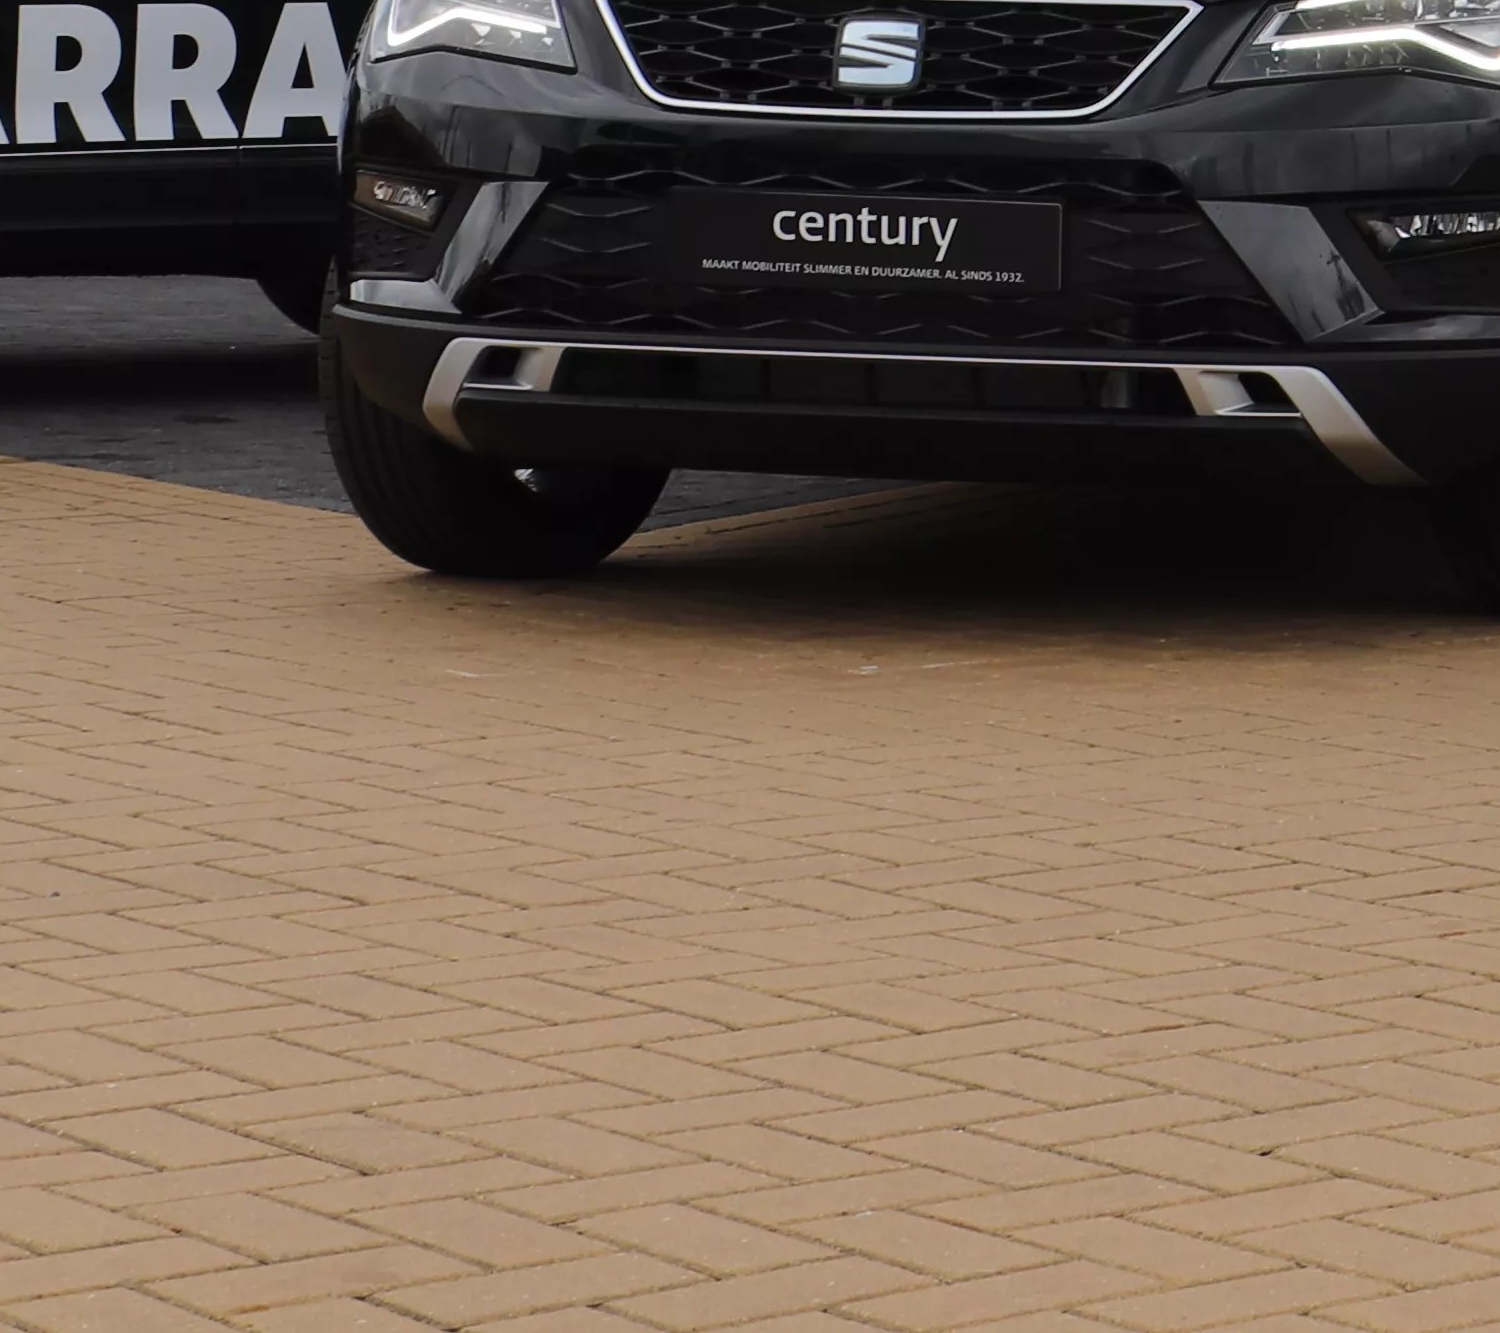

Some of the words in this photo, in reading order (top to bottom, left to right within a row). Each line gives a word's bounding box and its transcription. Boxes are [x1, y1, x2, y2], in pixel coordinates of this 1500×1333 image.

[773, 207, 958, 262] century
[702, 258, 740, 270] MAAKT
[742, 261, 801, 273] MOBILITEIT
[803, 263, 852, 275] SLIMMER
[854, 265, 869, 276] EN
[944, 269, 959, 280] AL
[961, 270, 993, 282] SINDS
[995, 271, 1025, 283] 1932.
